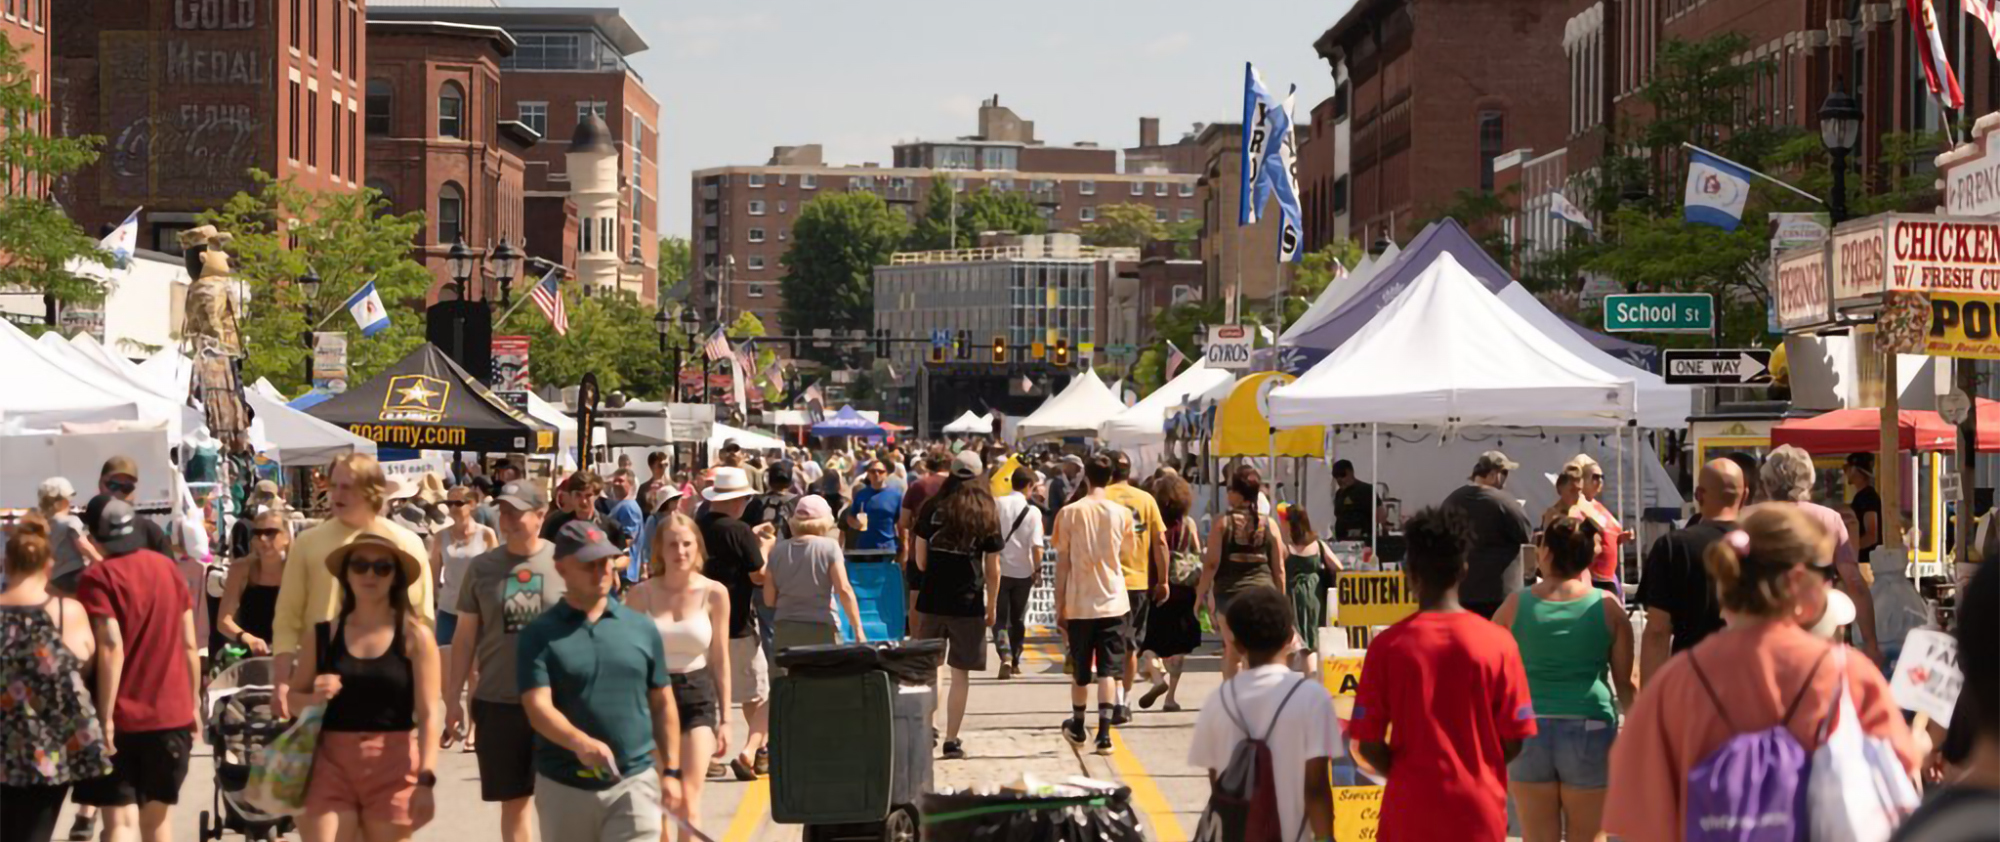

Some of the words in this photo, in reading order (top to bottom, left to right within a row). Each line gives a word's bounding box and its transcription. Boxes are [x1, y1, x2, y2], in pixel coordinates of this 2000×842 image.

[174, 0, 256, 30] GOLD
[167, 39, 263, 85] MEDAL
[1894, 220, 2000, 264] CHICKEN
[1920, 266, 1974, 289] FRESH
[1617, 302, 1677, 323] School
[1929, 299, 2000, 341] PO
[1209, 343, 1249, 362] GYROS
[1676, 361, 1704, 375] ONE
[1712, 361, 1742, 375] WAY
[350, 424, 466, 448] goarmy.com
[1339, 576, 1399, 605] GLUTEN
